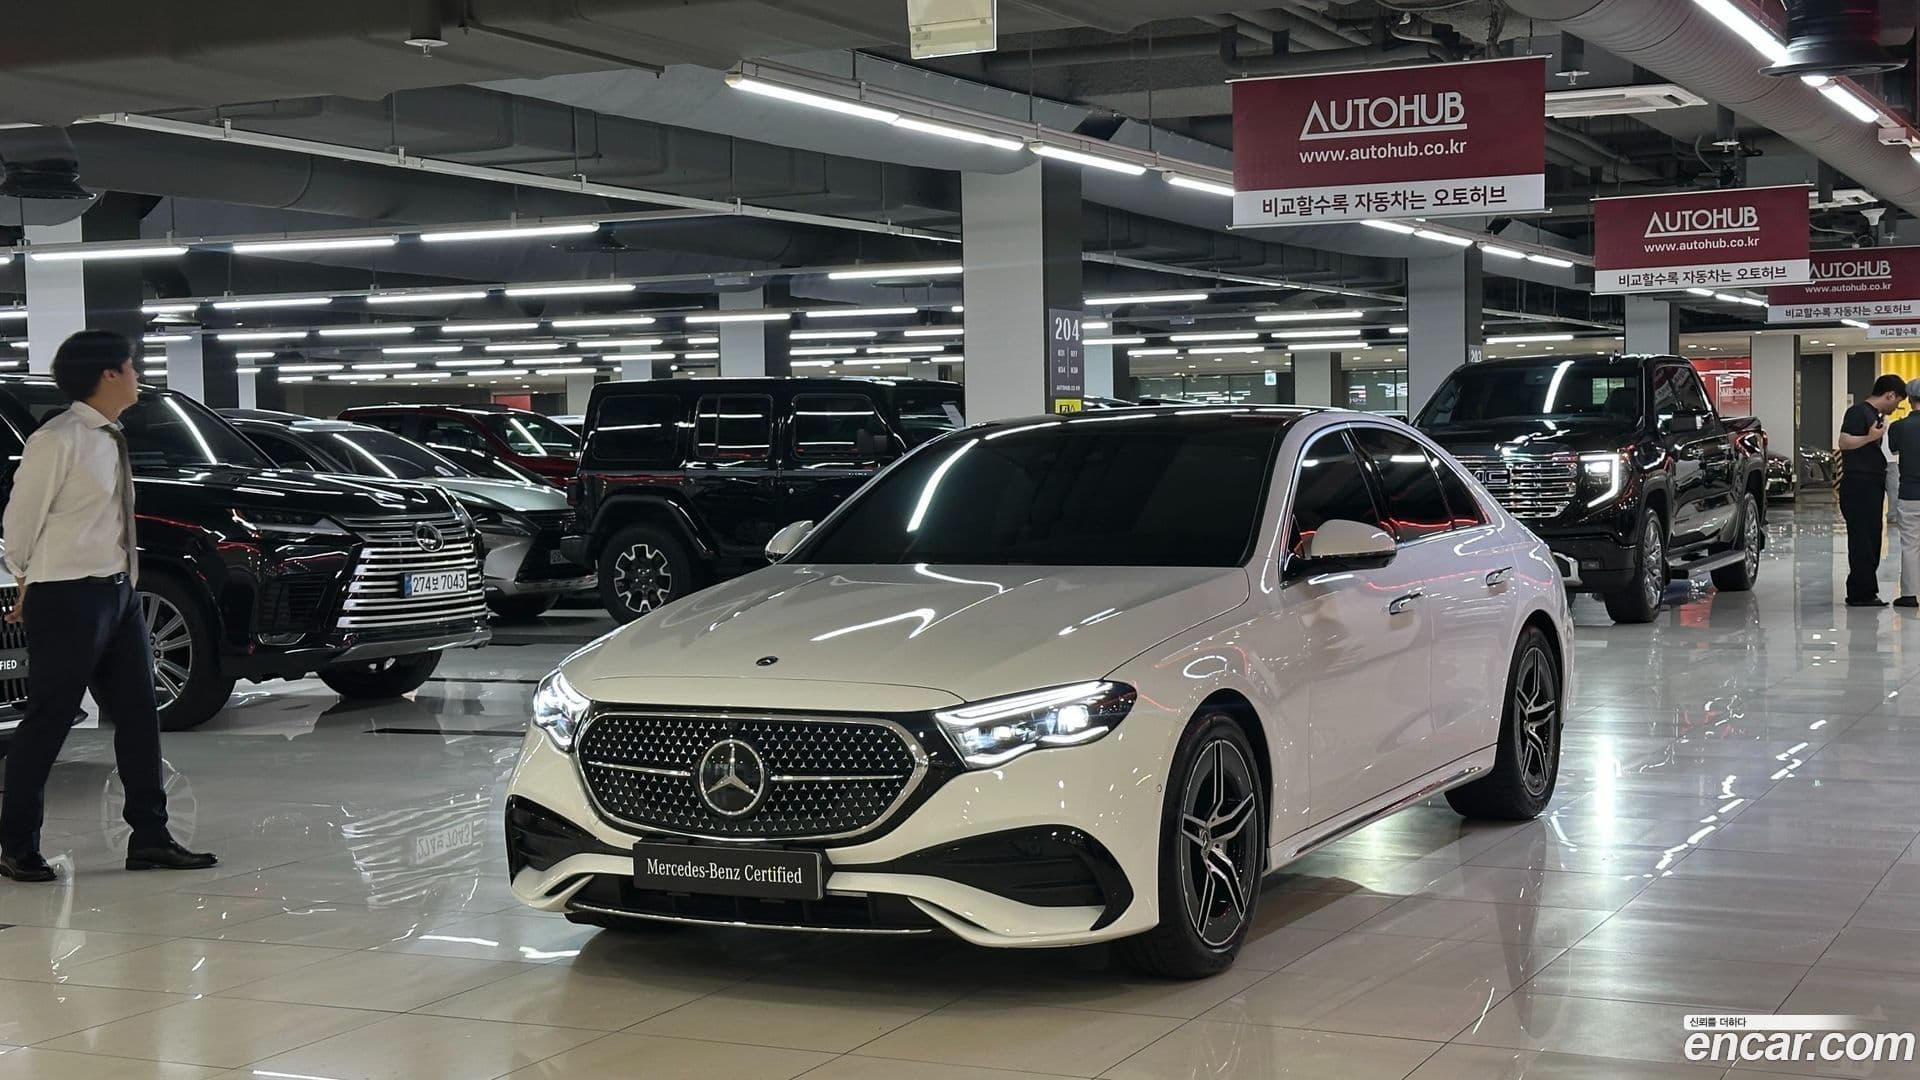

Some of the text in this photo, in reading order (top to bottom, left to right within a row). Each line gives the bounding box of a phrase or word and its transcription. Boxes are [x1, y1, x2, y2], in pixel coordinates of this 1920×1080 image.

[1299, 91, 1467, 141] AUTOHUB
[1300, 138, 1467, 163] www.autohub.co.kr
[1262, 185, 1507, 217] 비교할수록 자동차는 오토허브
[1644, 206, 1760, 238] AUTOHUB
[1644, 237, 1760, 253] www.autohub.co.kr
[1618, 266, 1788, 287] 비교할수록 자동차는 오토허브
[1809, 260, 1892, 281] AUTOHUB
[1805, 282, 1892, 294] www.autohub.co.kr
[1785, 304, 1913, 318] 비교할수록 자동차는 오토허브
[1055, 317, 1080, 341] 204
[413, 573, 465, 593] 274보 7043
[647, 858, 803, 884] Mercedes-Benz Certified
